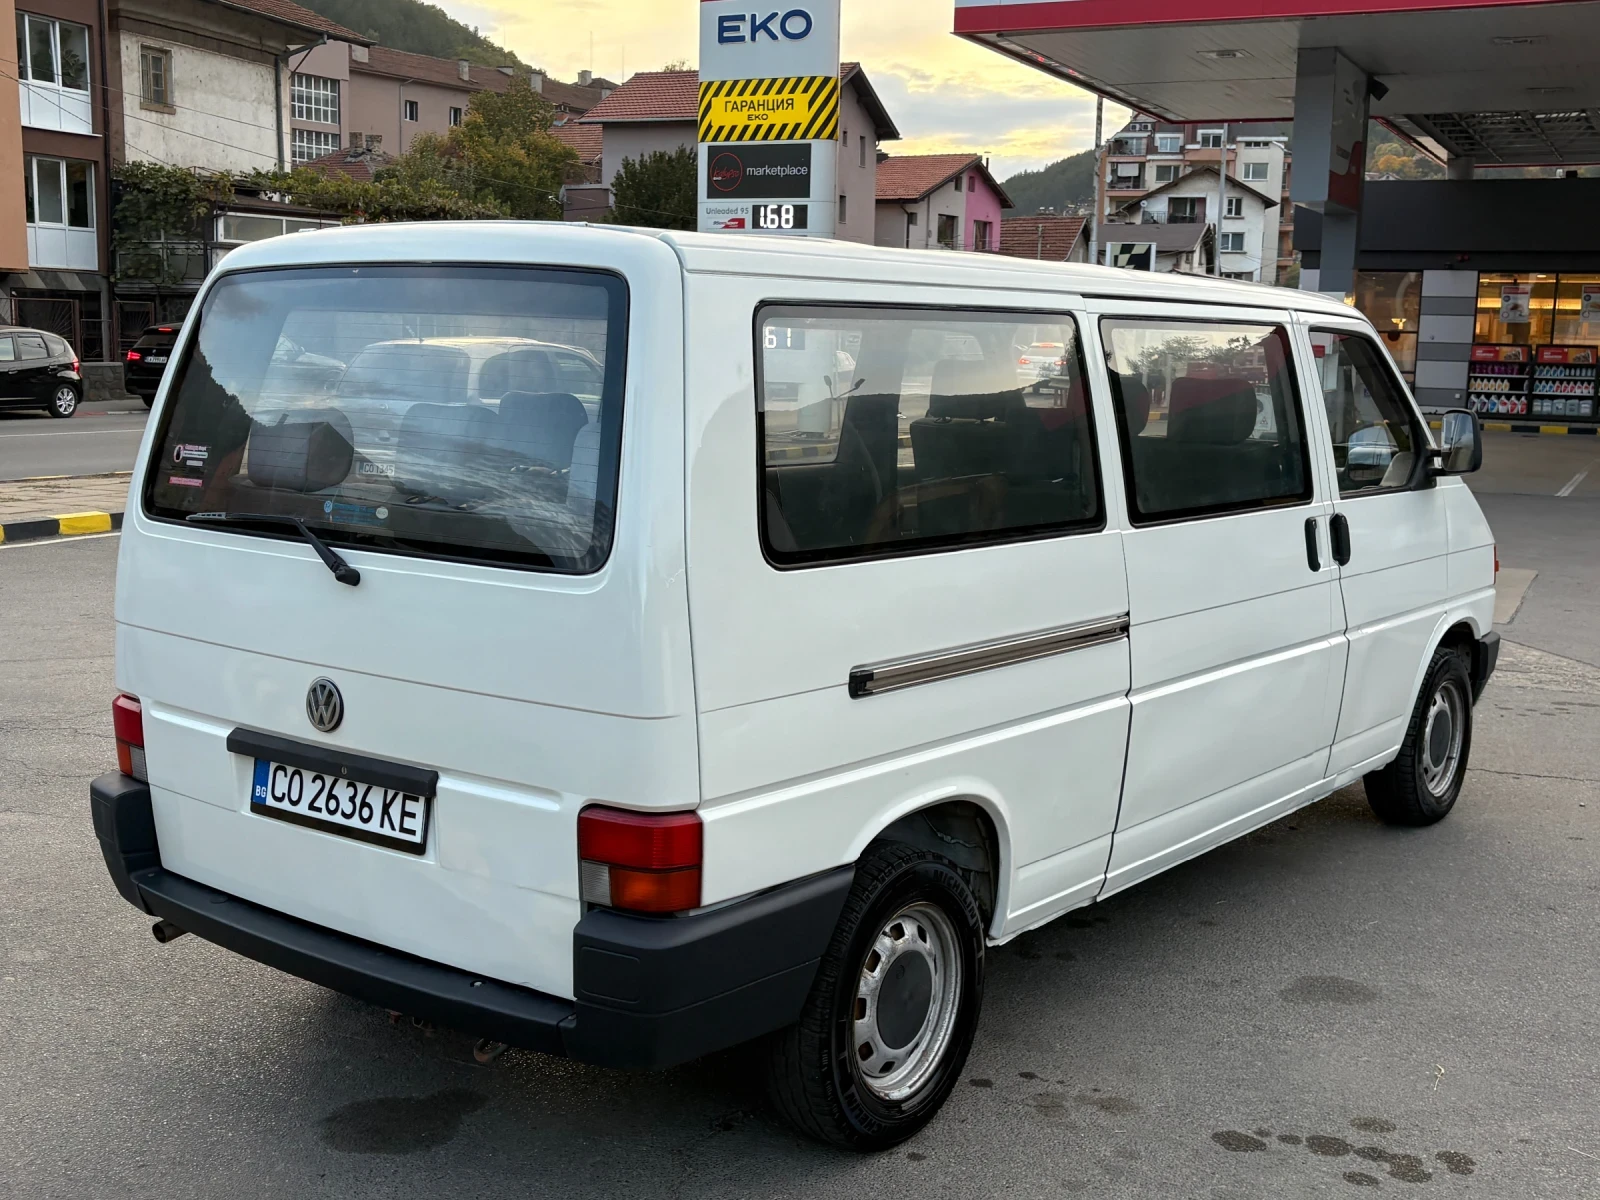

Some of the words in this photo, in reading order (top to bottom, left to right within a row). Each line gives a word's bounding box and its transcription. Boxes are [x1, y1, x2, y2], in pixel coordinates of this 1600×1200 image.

[718, 9, 812, 43] EKO
[724, 98, 794, 113] ГАРАНЦИЯ
[747, 113, 768, 121] EKO
[747, 165, 808, 177] marketplace
[706, 206, 738, 215] Unleaded
[740, 207, 749, 215] 95
[760, 204, 794, 229] 1.68
[255, 785, 266, 798] BG
[271, 765, 303, 806] CO
[308, 774, 373, 824] 2636
[379, 789, 419, 836] KE
[932, 868, 977, 921] MICHELIN
